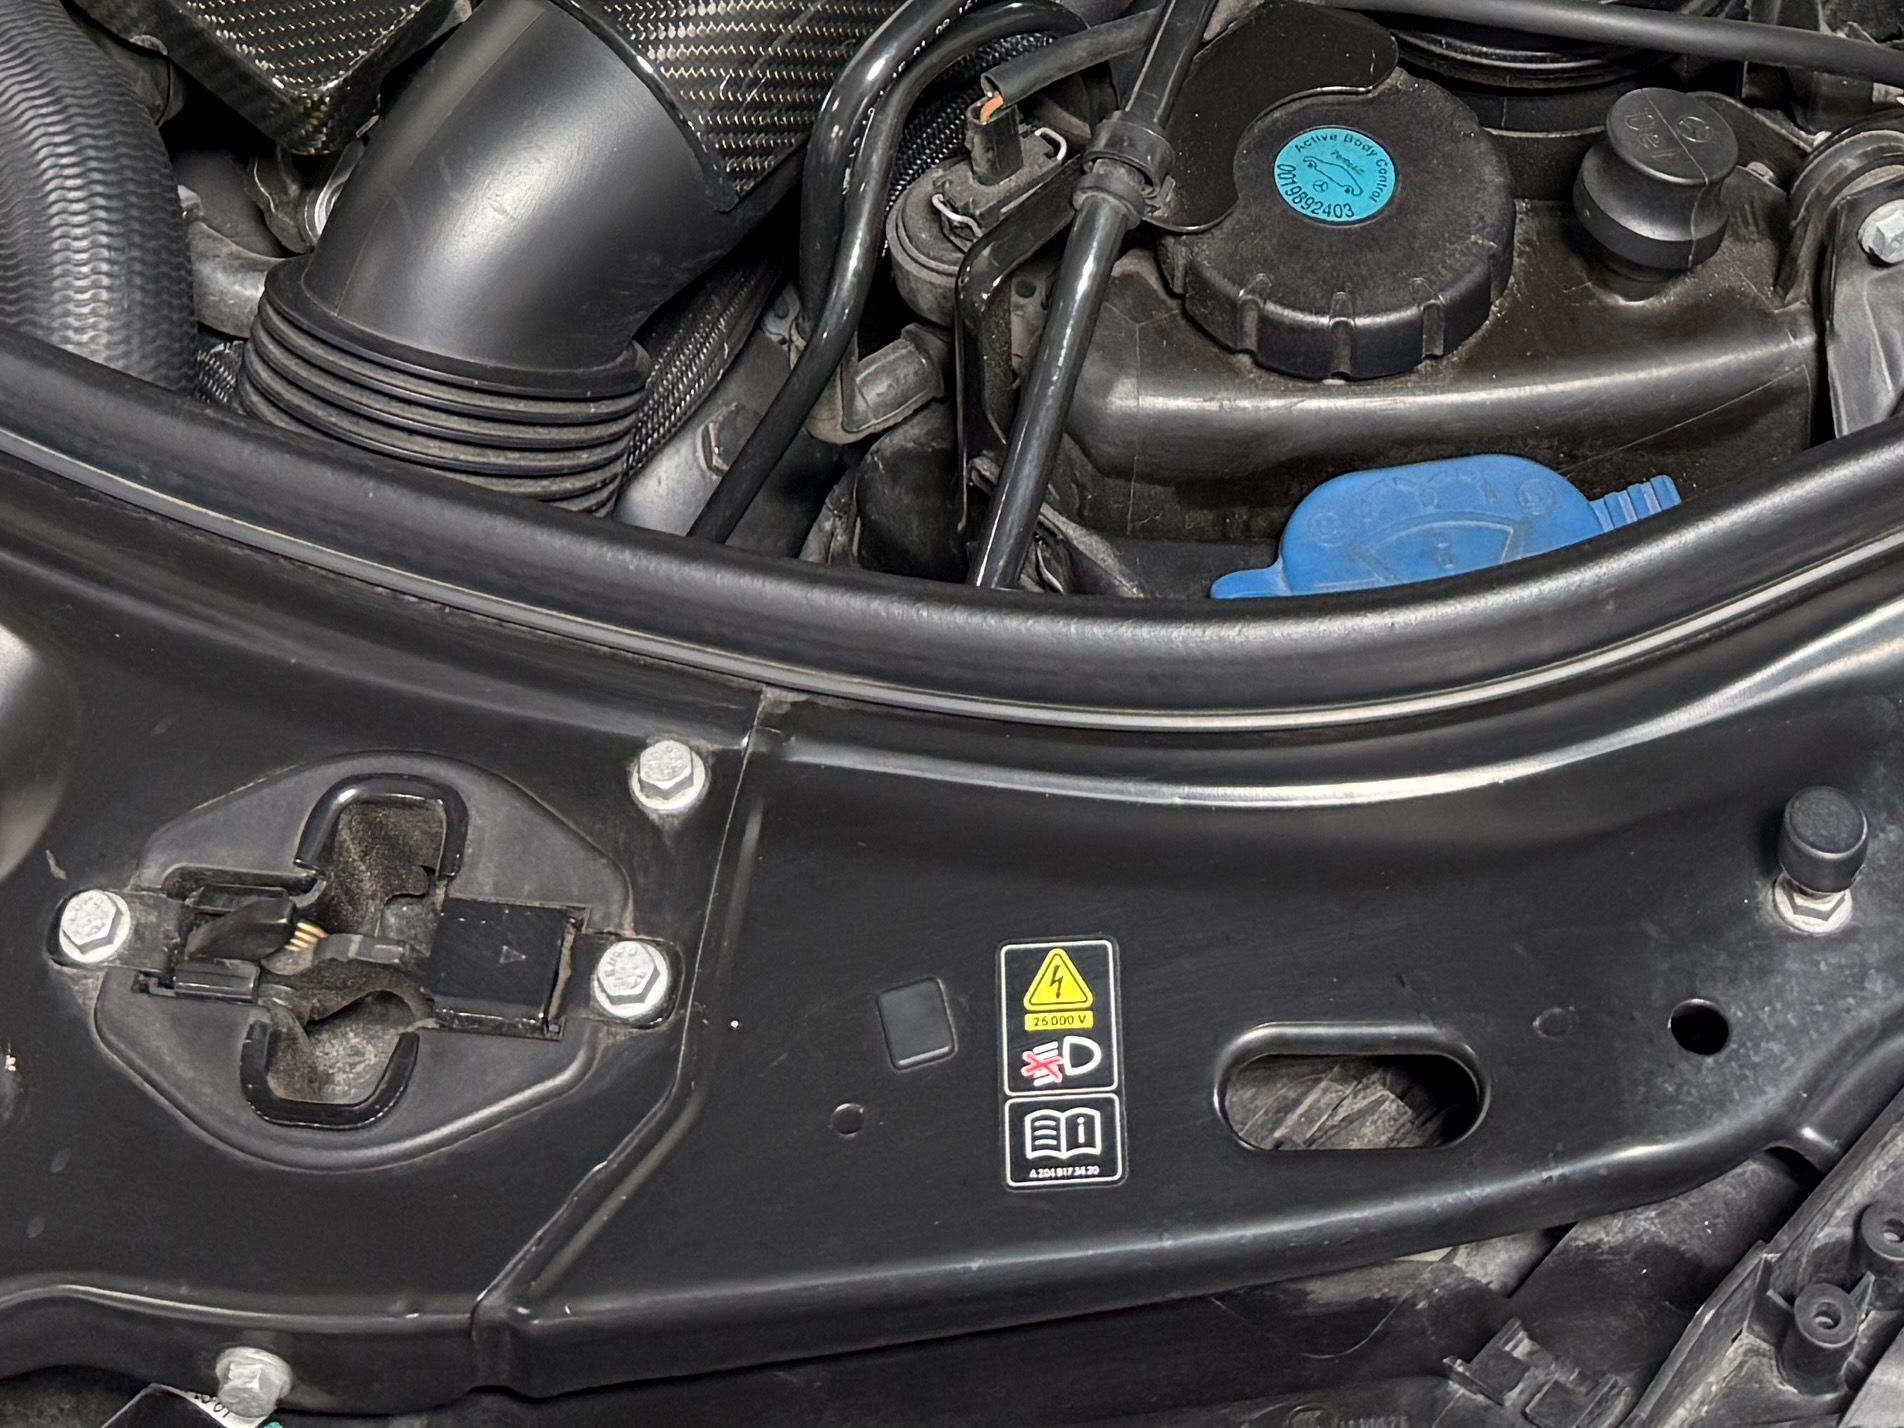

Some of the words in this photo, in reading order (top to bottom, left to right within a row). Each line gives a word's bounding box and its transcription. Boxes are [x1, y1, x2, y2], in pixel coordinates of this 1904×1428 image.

[1277, 163, 1354, 218] 0019892403
[1295, 134, 1337, 152] Active
[1344, 134, 1378, 157] Body
[1370, 159, 1388, 204] Control
[1077, 1014, 1087, 1024] V
